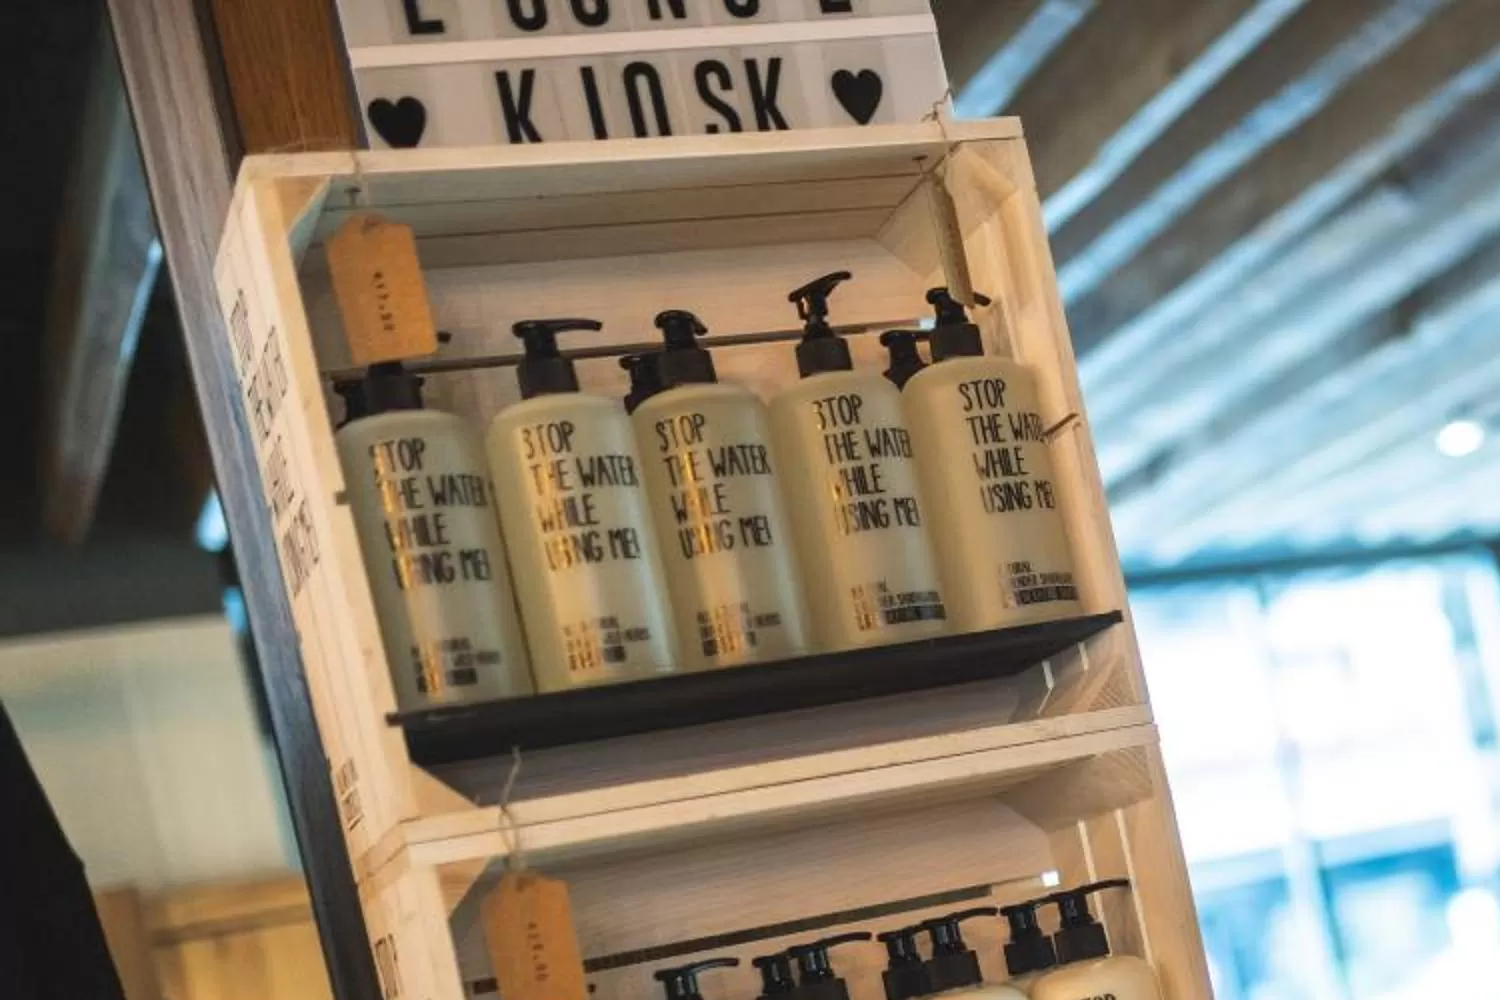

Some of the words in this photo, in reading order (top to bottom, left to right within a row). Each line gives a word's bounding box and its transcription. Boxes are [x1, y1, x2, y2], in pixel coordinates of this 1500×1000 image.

[495, 57, 791, 146] KIOSK
[958, 378, 1006, 412] STOP
[522, 420, 576, 460] STOP
[655, 412, 705, 453] STOP
[966, 413, 1007, 445] THE
[576, 455, 639, 488] WATER
[707, 444, 773, 477] WATER
[972, 446, 1031, 480] WHILE
[980, 480, 1032, 513] USING
